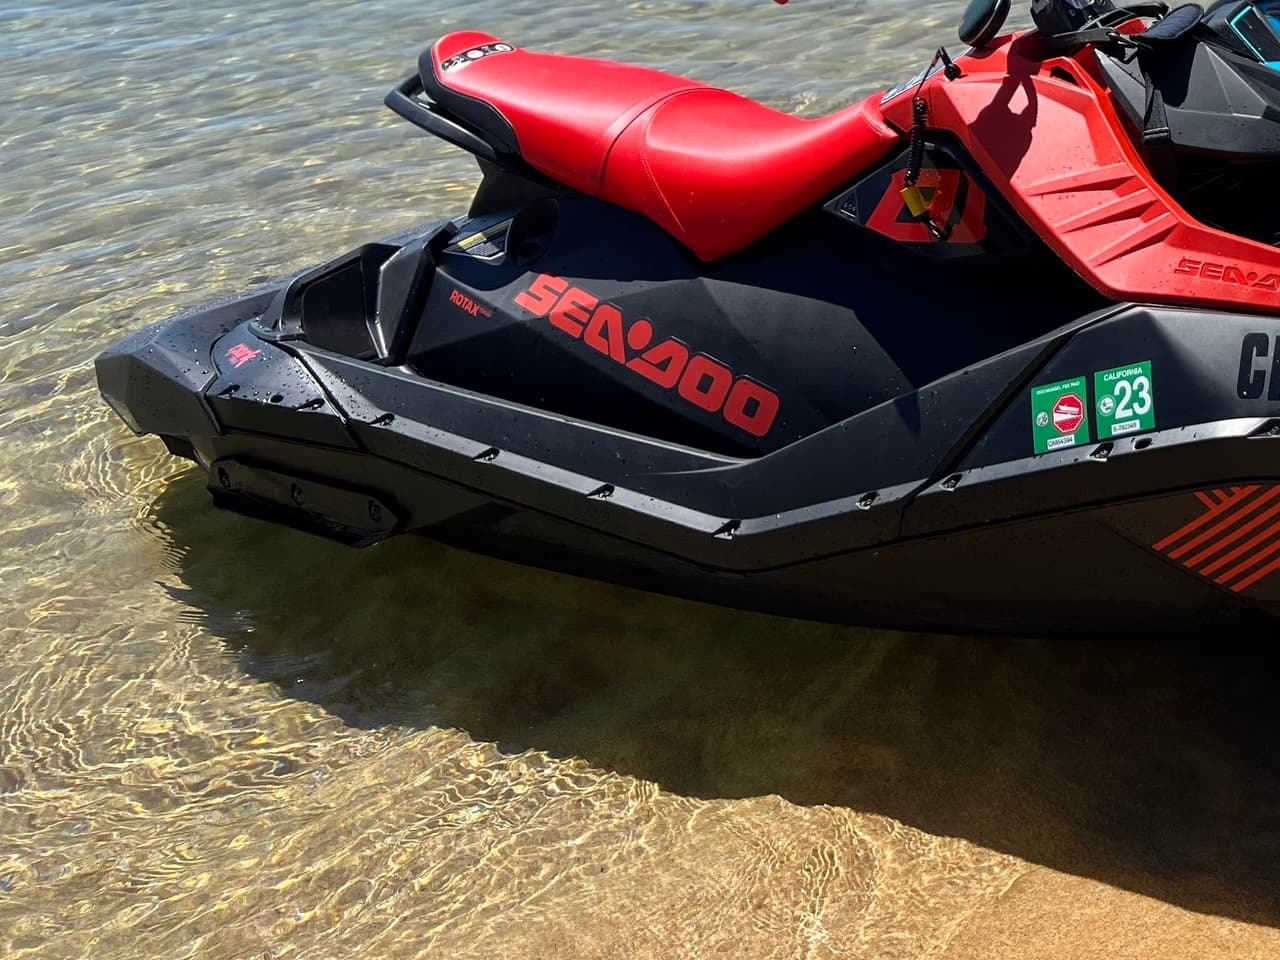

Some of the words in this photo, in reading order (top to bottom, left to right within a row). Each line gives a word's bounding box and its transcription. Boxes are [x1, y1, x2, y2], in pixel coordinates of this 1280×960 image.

[449, 289, 481, 317] ROTAX
[1103, 367, 1143, 382] CALIFORNIA
[1113, 375, 1152, 420] 23
